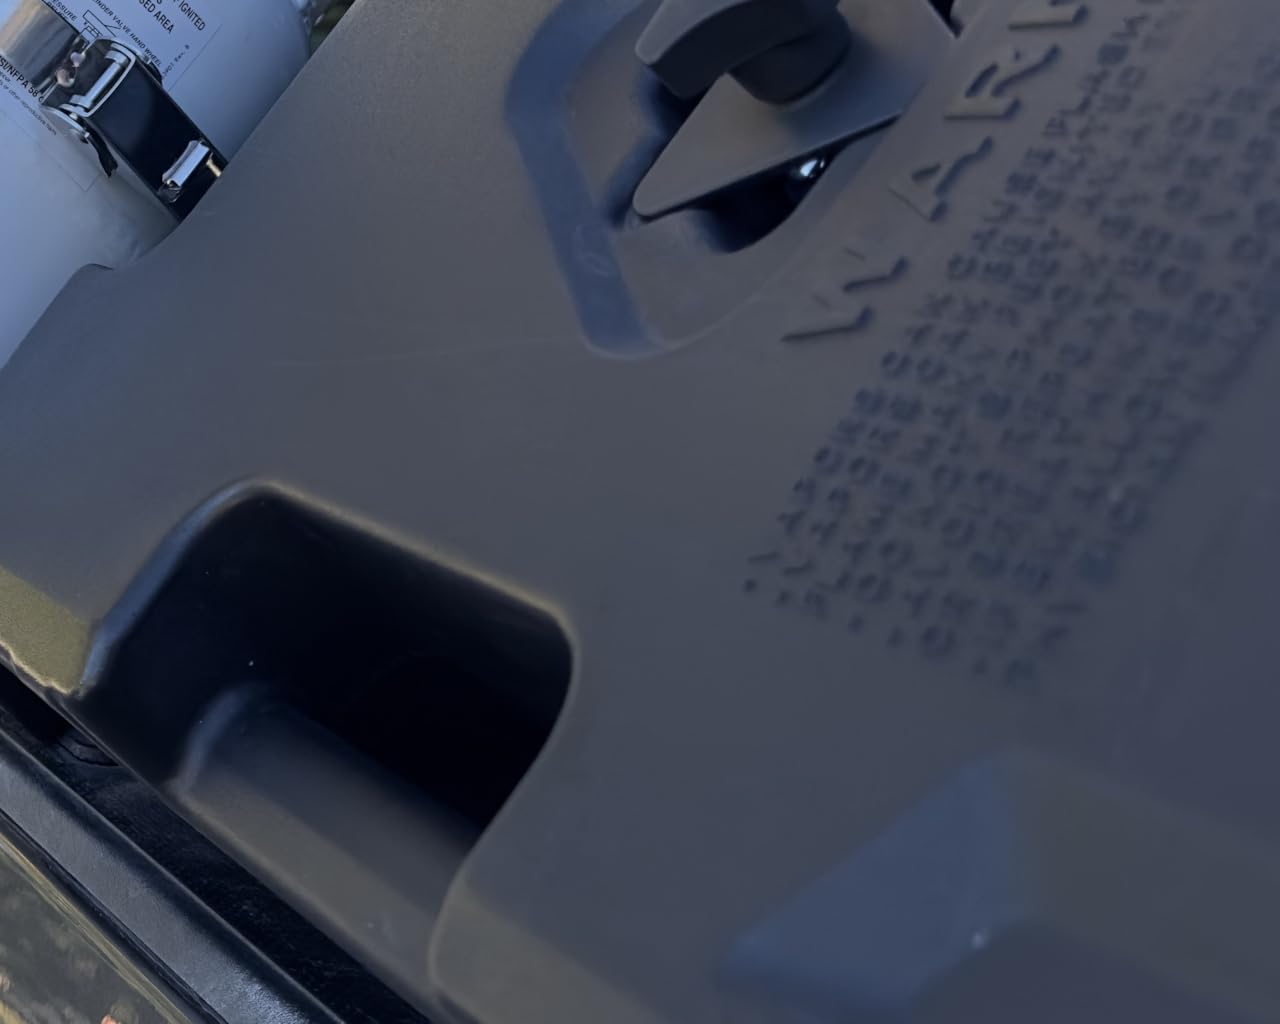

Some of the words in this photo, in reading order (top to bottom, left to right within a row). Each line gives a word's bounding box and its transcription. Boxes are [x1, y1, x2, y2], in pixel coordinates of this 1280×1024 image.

[153, 10, 175, 33] AREA
[177, 0, 206, 31] IGNITED
[111, 15, 130, 33] VALVE
[128, 32, 145, 49] HAND
[143, 47, 162, 67] WHEEL
[27, 85, 39, 97] 58
